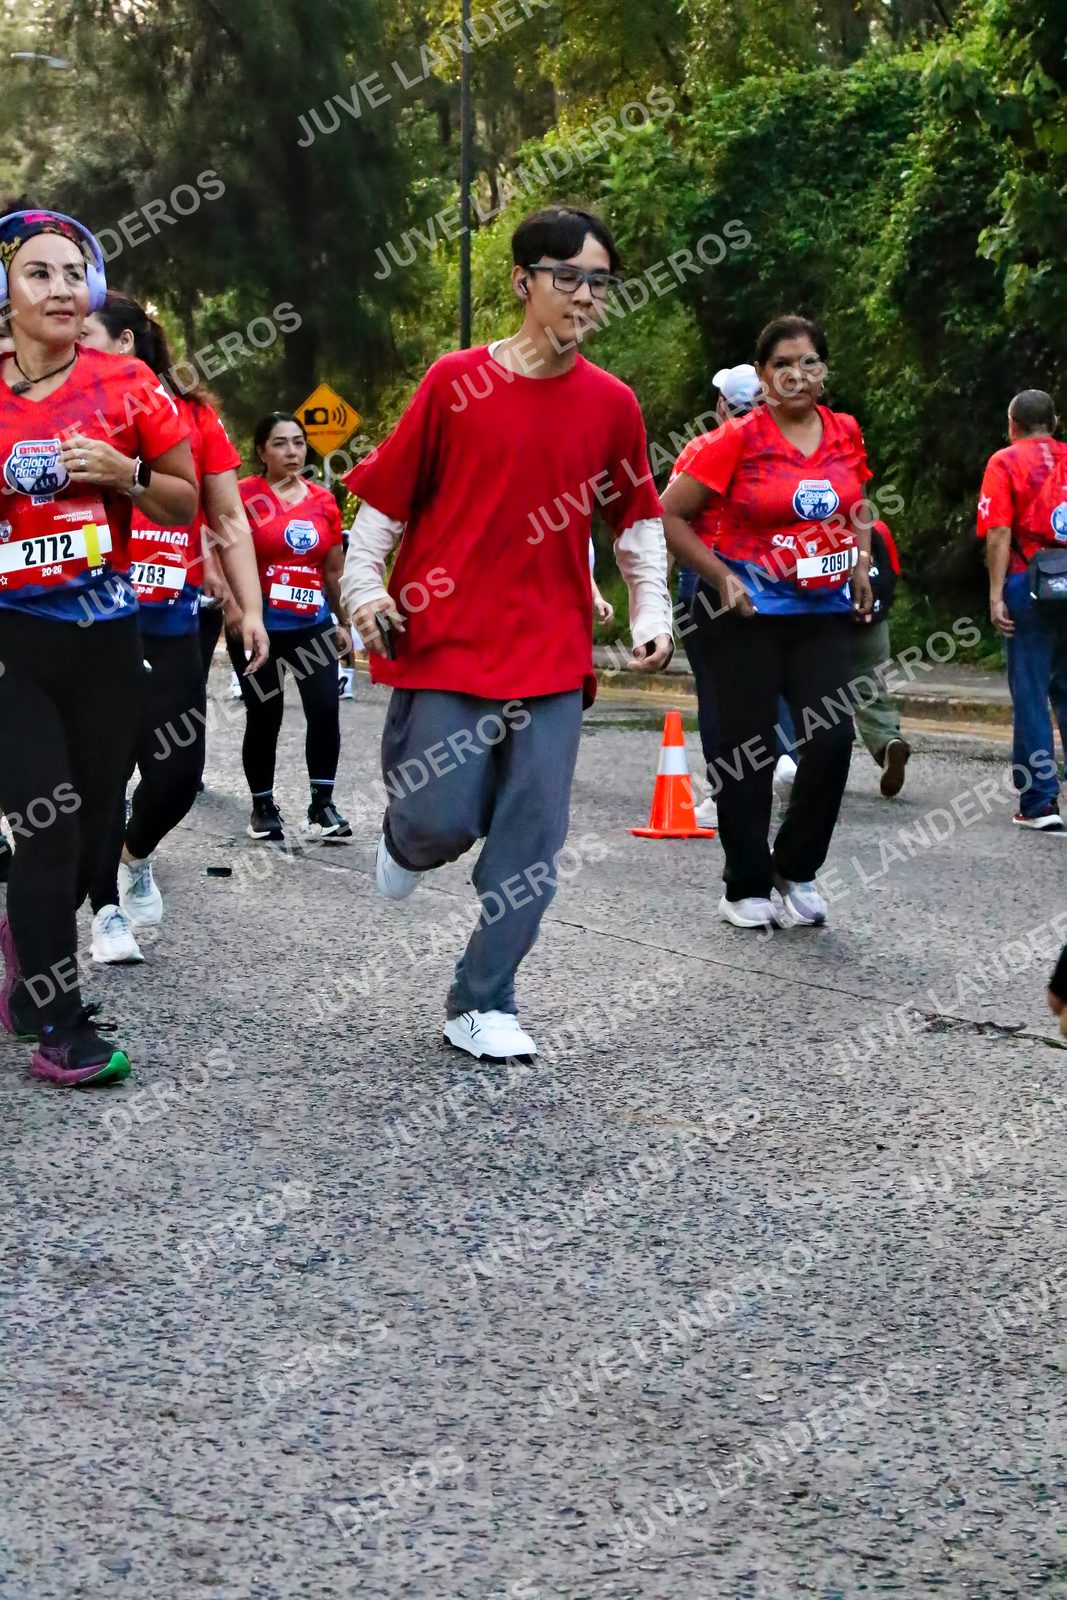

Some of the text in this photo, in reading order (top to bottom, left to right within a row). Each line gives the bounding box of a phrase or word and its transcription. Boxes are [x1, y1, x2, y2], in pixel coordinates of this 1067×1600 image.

[19, 445, 56, 454] BIMBO
[20, 457, 55, 468] Global
[15, 467, 43, 478] Race
[21, 534, 75, 566] 2772
[821, 553, 846, 574] 2091
[290, 587, 315, 603] 1429
